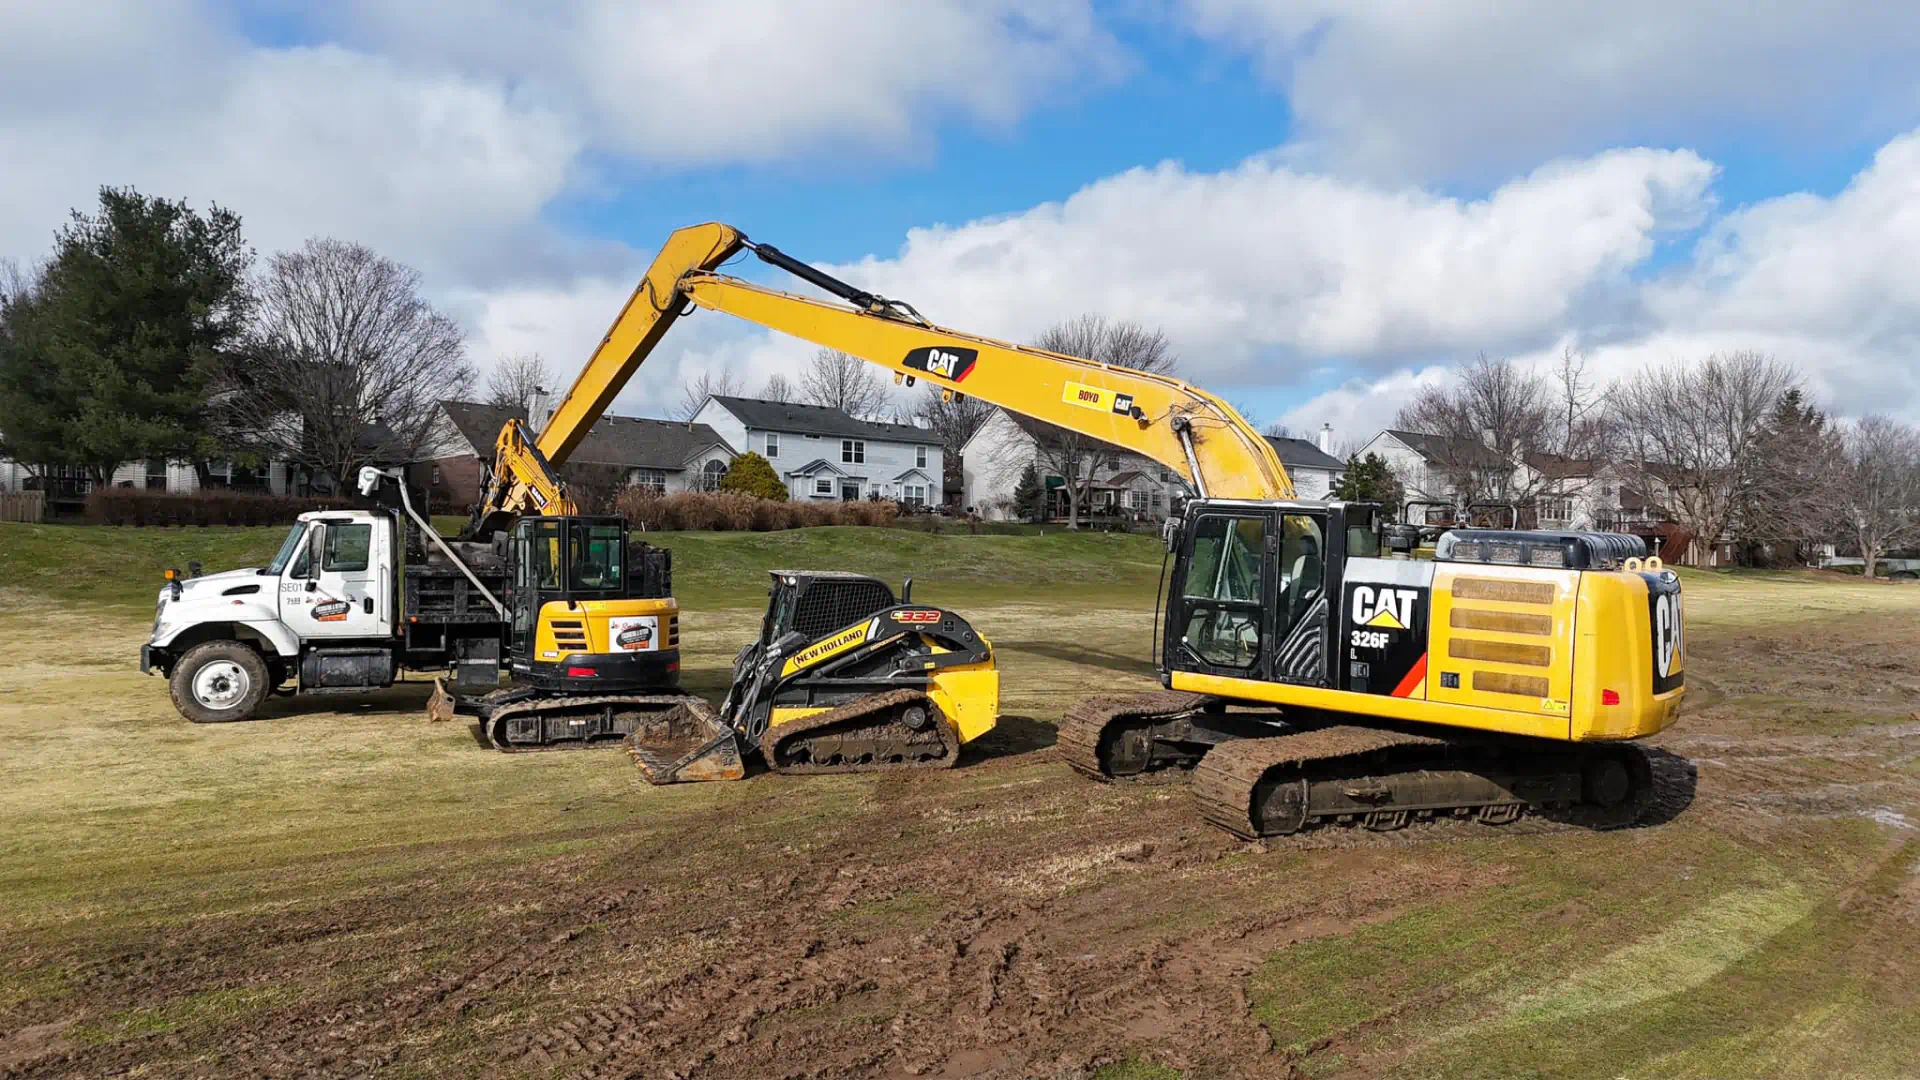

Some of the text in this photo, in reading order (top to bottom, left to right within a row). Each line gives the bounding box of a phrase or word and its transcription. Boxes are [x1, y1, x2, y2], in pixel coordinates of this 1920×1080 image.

[926, 349, 959, 379] CAT
[1078, 389, 1099, 404] BOYD
[1115, 397, 1131, 410] CAT
[281, 583, 302, 592] SE01
[1352, 586, 1418, 630] CAT
[796, 649, 819, 664] NEW
[820, 629, 863, 654] HOLLAND
[1351, 631, 1389, 649] 326F
[1350, 649, 1357, 660] L
